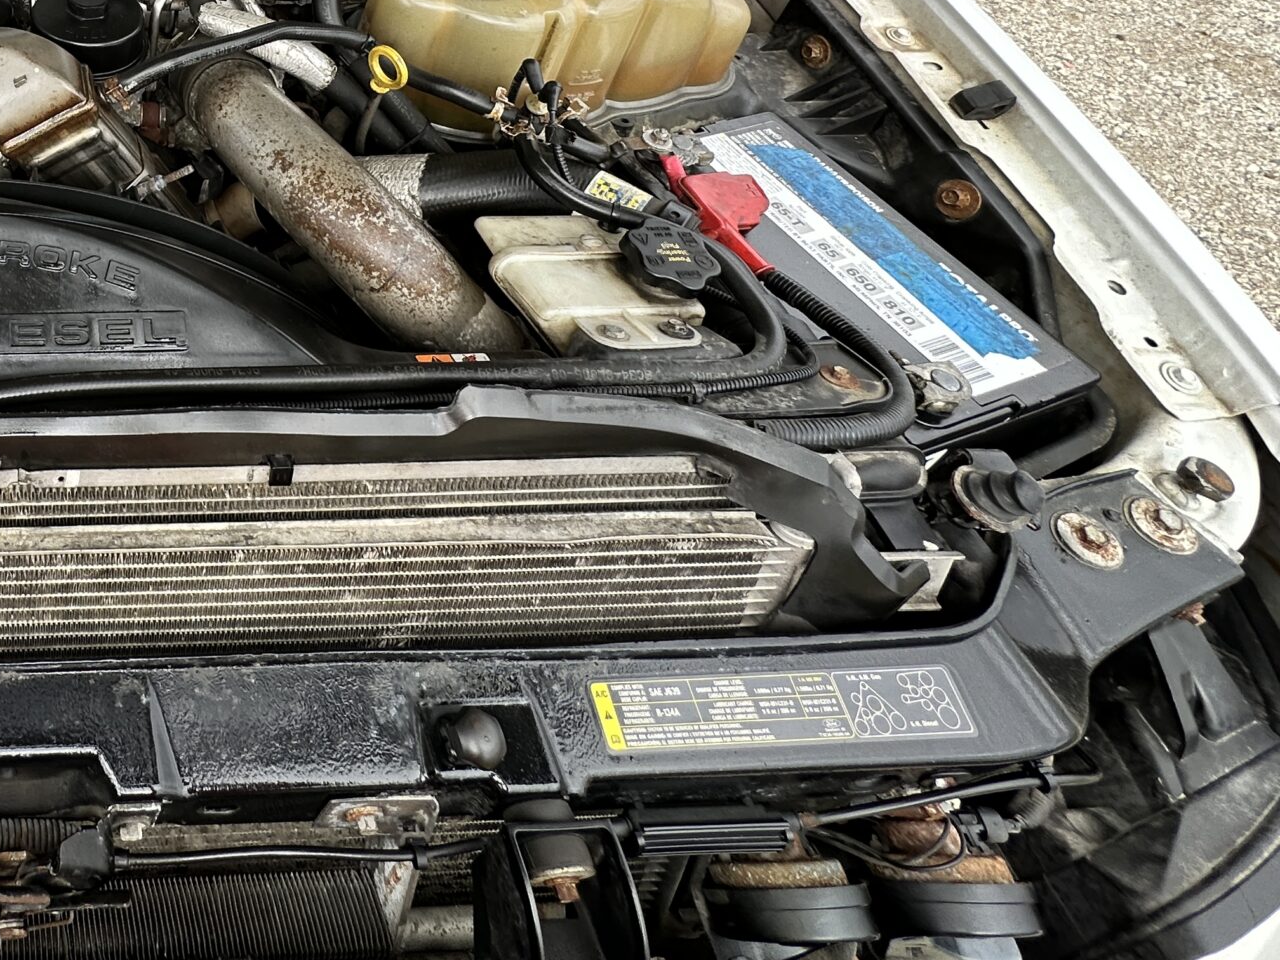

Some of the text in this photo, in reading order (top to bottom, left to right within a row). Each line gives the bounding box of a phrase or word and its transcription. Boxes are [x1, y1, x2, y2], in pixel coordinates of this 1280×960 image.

[769, 201, 805, 228] 65-T
[816, 241, 840, 259] 65
[844, 266, 877, 293] 650
[882, 298, 917, 327] 810
[647, 686, 681, 697] SAE J639
[654, 707, 680, 717] R-134A
